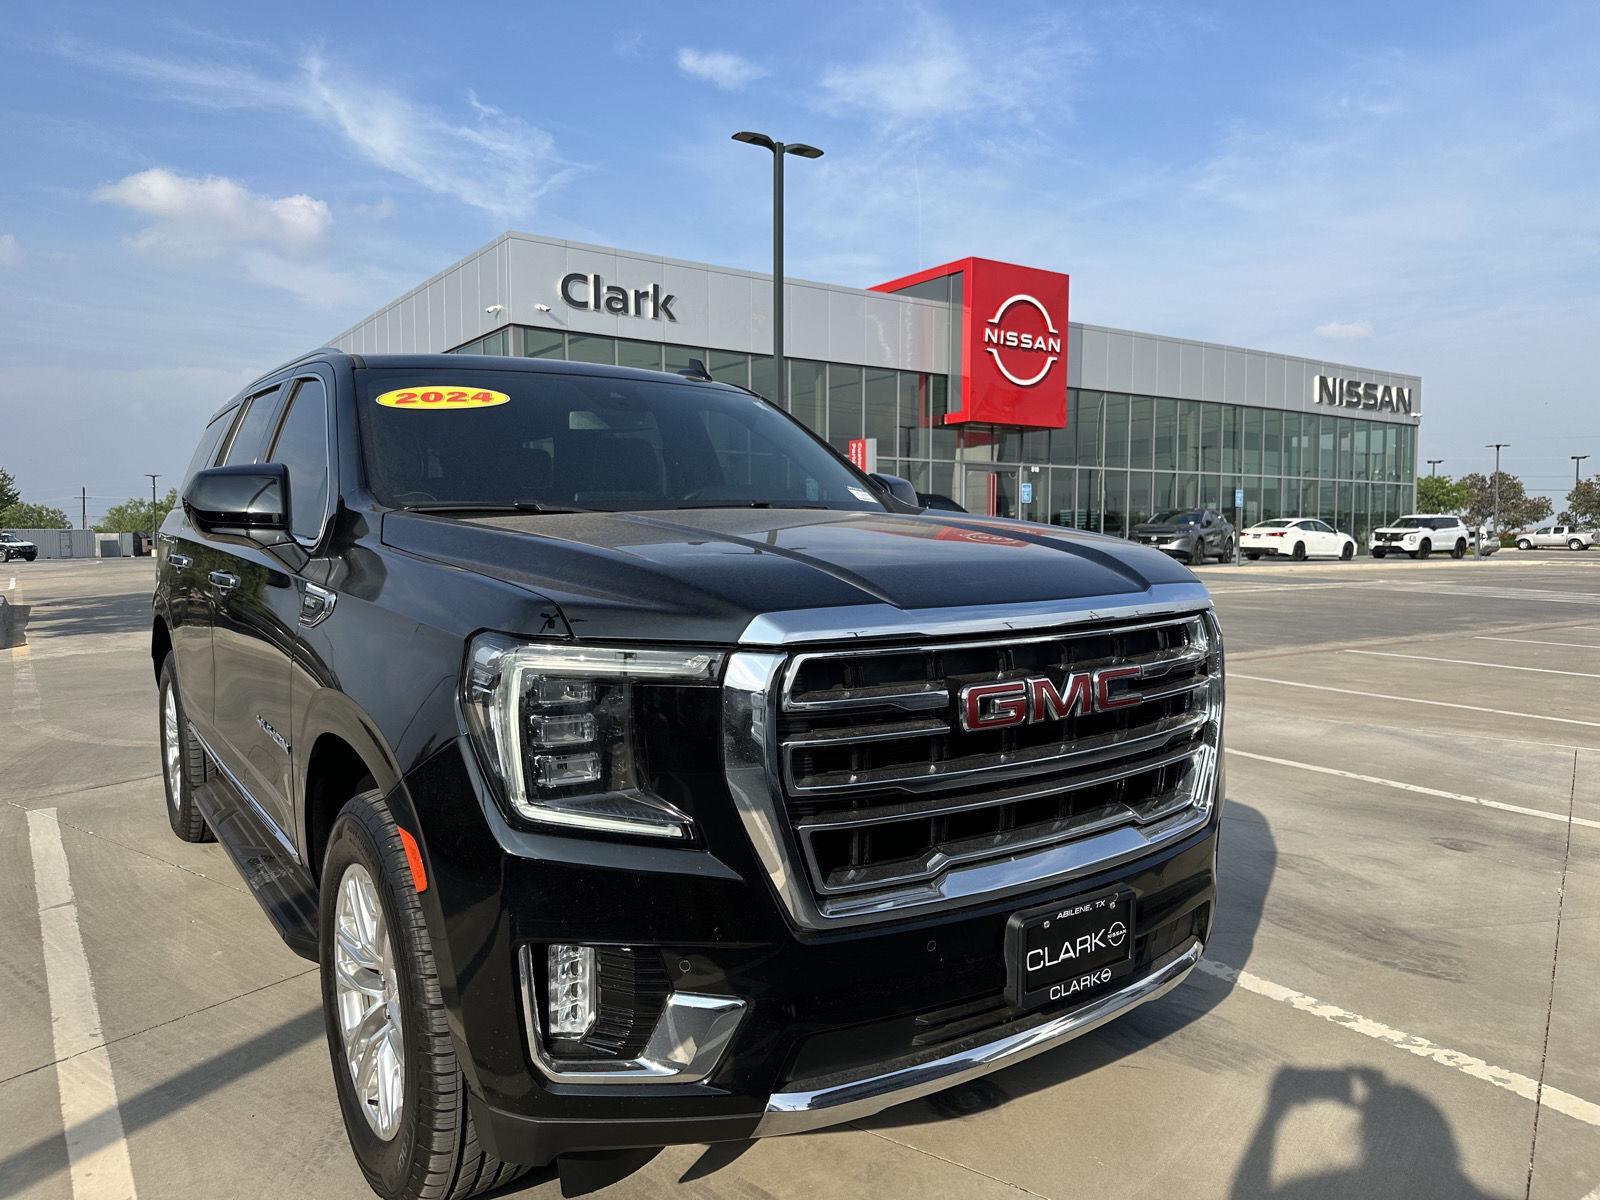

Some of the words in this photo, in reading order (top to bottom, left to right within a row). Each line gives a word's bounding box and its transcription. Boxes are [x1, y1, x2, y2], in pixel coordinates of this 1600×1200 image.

[559, 272, 677, 322] Clark
[984, 327, 1061, 353] NISSAN
[395, 391, 494, 404] 2024
[1313, 374, 1412, 414] NISSAN
[958, 664, 1143, 733] GMC
[1096, 900, 1106, 909] TX
[1107, 928, 1127, 940] NISSAN
[1026, 928, 1106, 971] CLARK
[1049, 971, 1101, 1000] CLARK
